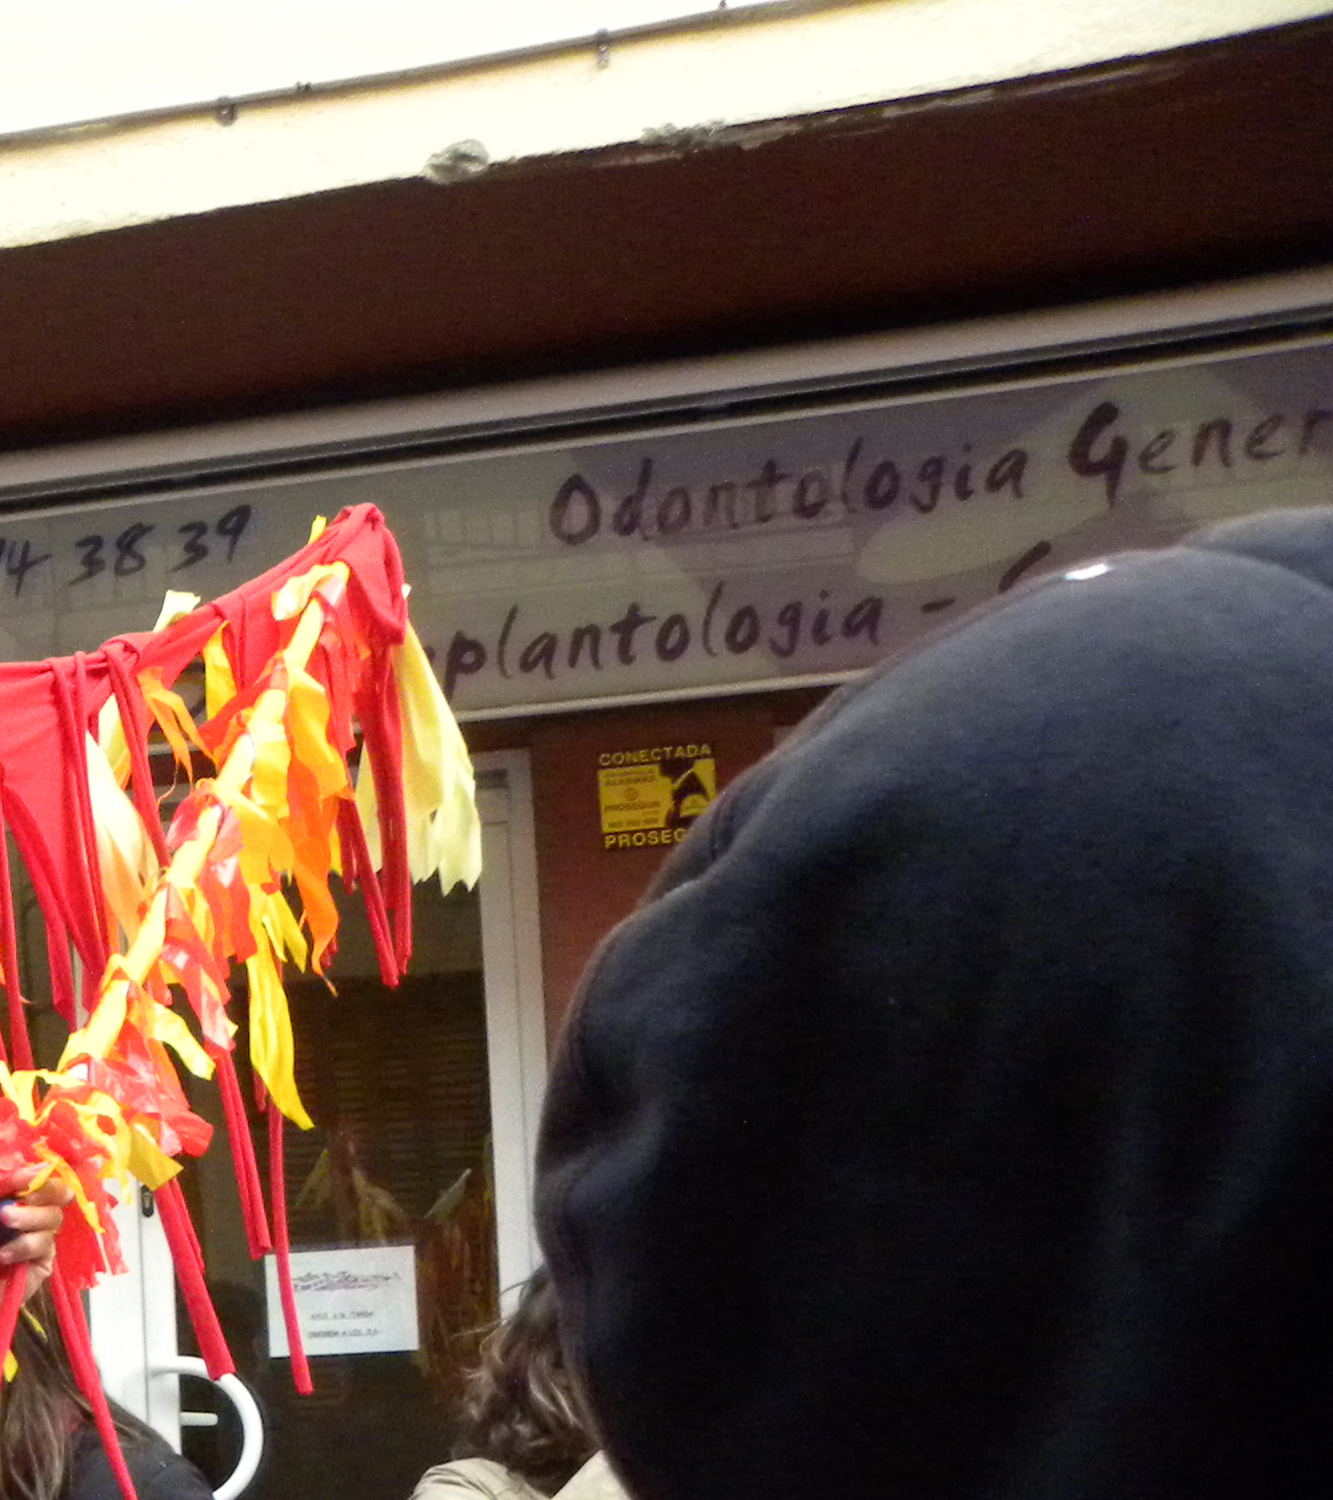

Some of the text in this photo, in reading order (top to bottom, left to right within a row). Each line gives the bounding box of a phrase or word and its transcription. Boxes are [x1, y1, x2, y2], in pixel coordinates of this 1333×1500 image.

[549, 437, 1029, 544] Odontologia
[69, 522, 156, 586] 38
[170, 504, 253, 572] 39
[424, 581, 884, 700] plantologia
[598, 743, 712, 767] CONECTADA
